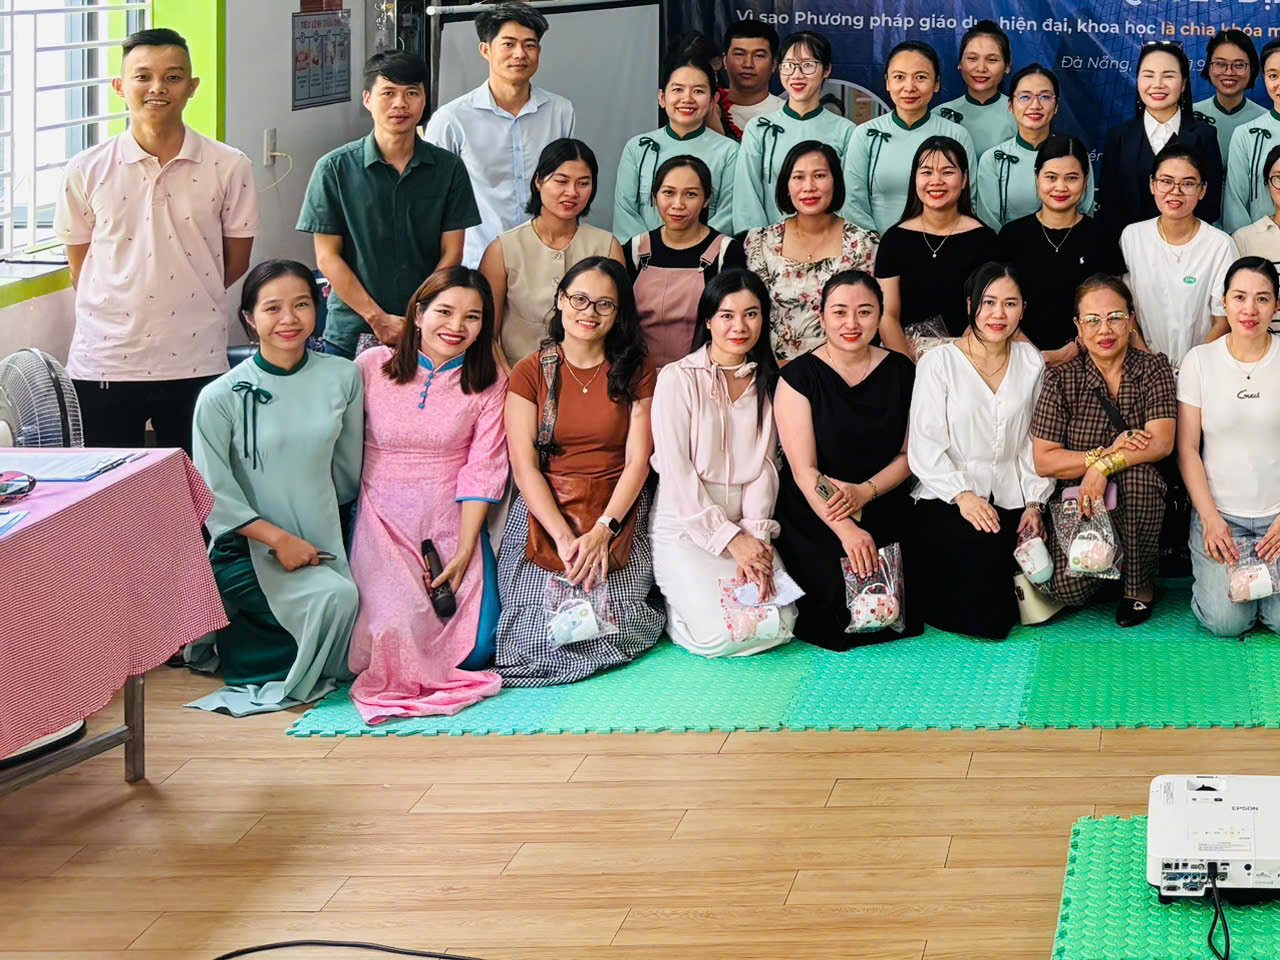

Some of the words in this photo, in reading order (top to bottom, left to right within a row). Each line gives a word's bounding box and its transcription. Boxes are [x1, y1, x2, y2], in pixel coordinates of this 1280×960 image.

[759, 13, 789, 24] sao
[795, 11, 864, 29] Phương
[869, 13, 915, 31] pháp
[919, 14, 957, 31] giáo
[1000, 16, 1037, 34] hiện
[1042, 18, 1072, 35] đại,
[1077, 19, 1119, 33] khoa
[1125, 20, 1156, 37] học
[1161, 21, 1176, 35] là
[1180, 22, 1216, 36] chìa
[1061, 56, 1083, 68] Đà
